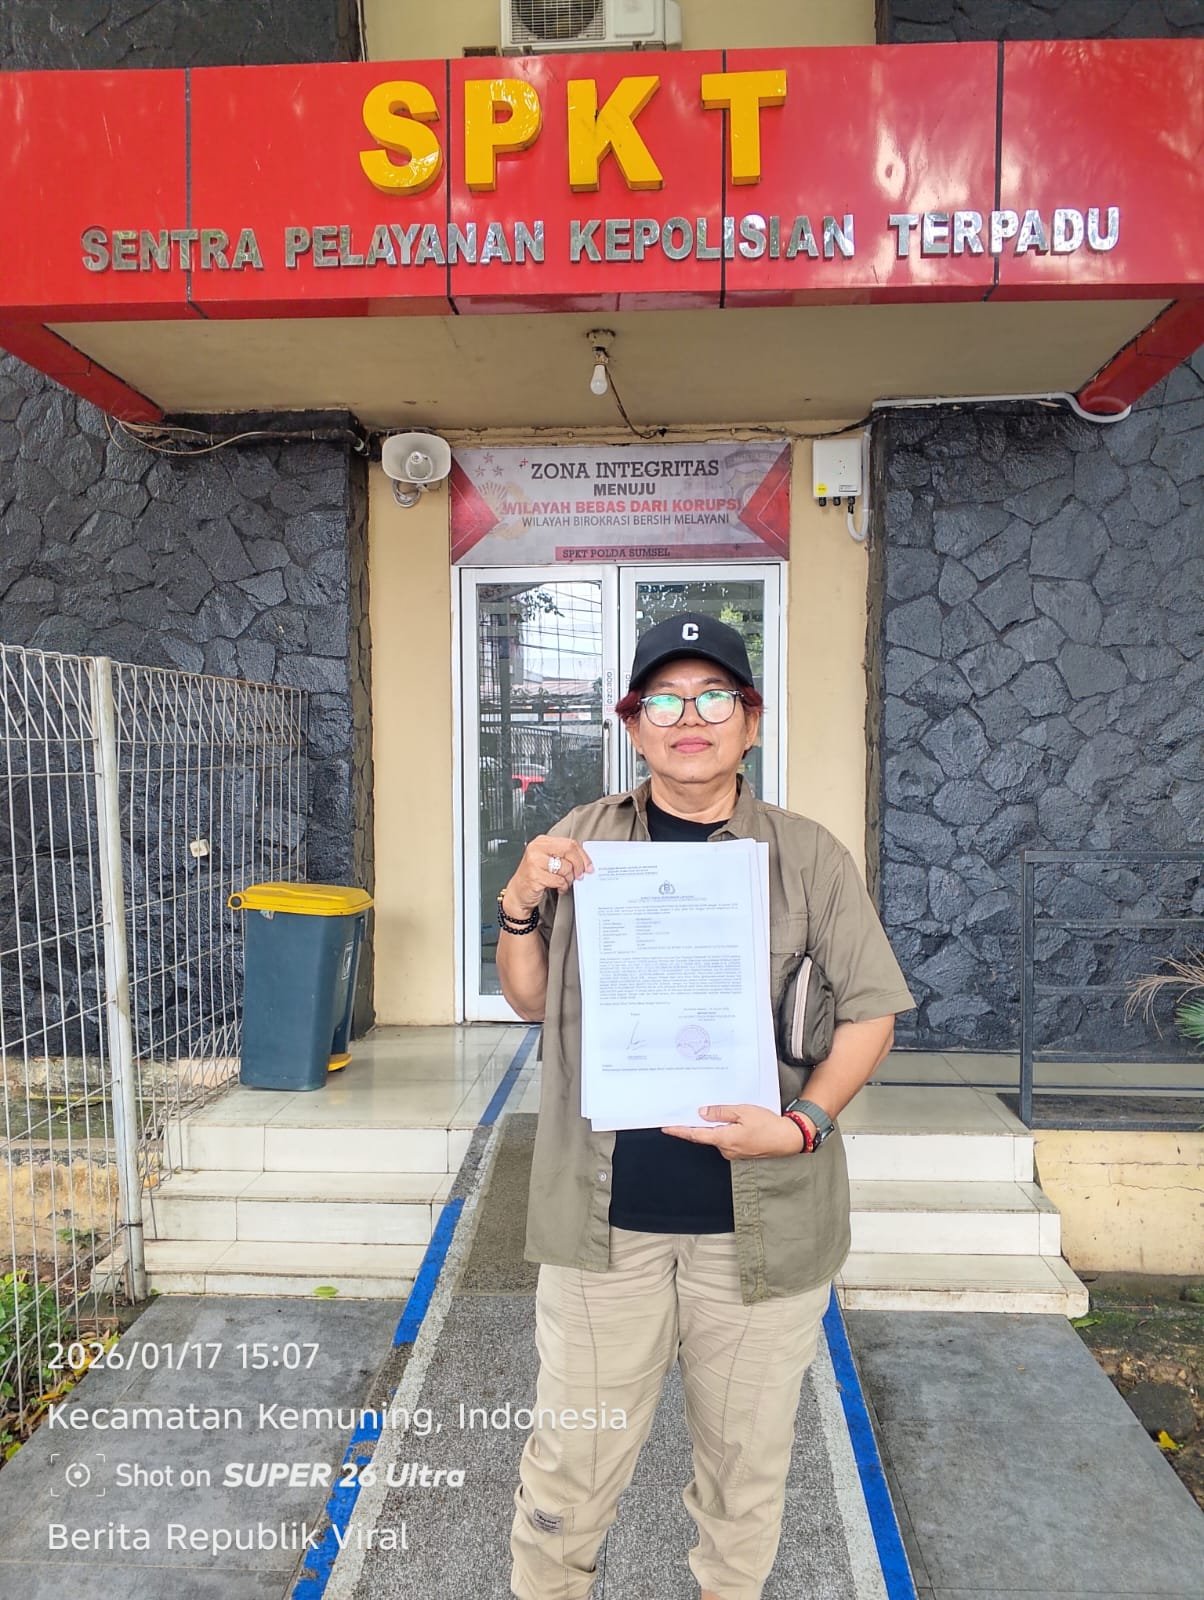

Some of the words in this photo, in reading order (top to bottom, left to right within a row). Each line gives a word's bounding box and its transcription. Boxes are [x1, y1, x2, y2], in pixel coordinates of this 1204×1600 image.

[360, 70, 789, 195] SPKT
[81, 225, 264, 272] SENTRA
[285, 219, 545, 268] PELAYANAN
[569, 213, 856, 263] KEPOLISIAN
[888, 206, 1121, 257] TERPADU
[531, 462, 590, 479] ZONA
[595, 459, 720, 479] INTEGRITAS
[593, 482, 656, 497] MENUJU
[502, 501, 571, 515] WILAYAH
[575, 500, 626, 514] BEBAS
[630, 500, 668, 513] DARI
[672, 498, 741, 513] KORUPSI
[522, 516, 570, 527] WILAYAH
[573, 515, 630, 527] BIROKRASI
[633, 514, 671, 526] BERSIH
[674, 513, 730, 525] MELAYANI
[562, 549, 588, 559] SPKT
[590, 548, 627, 559] POLDA
[628, 547, 671, 558] SUMSEL
[682, 623, 699, 641] C
